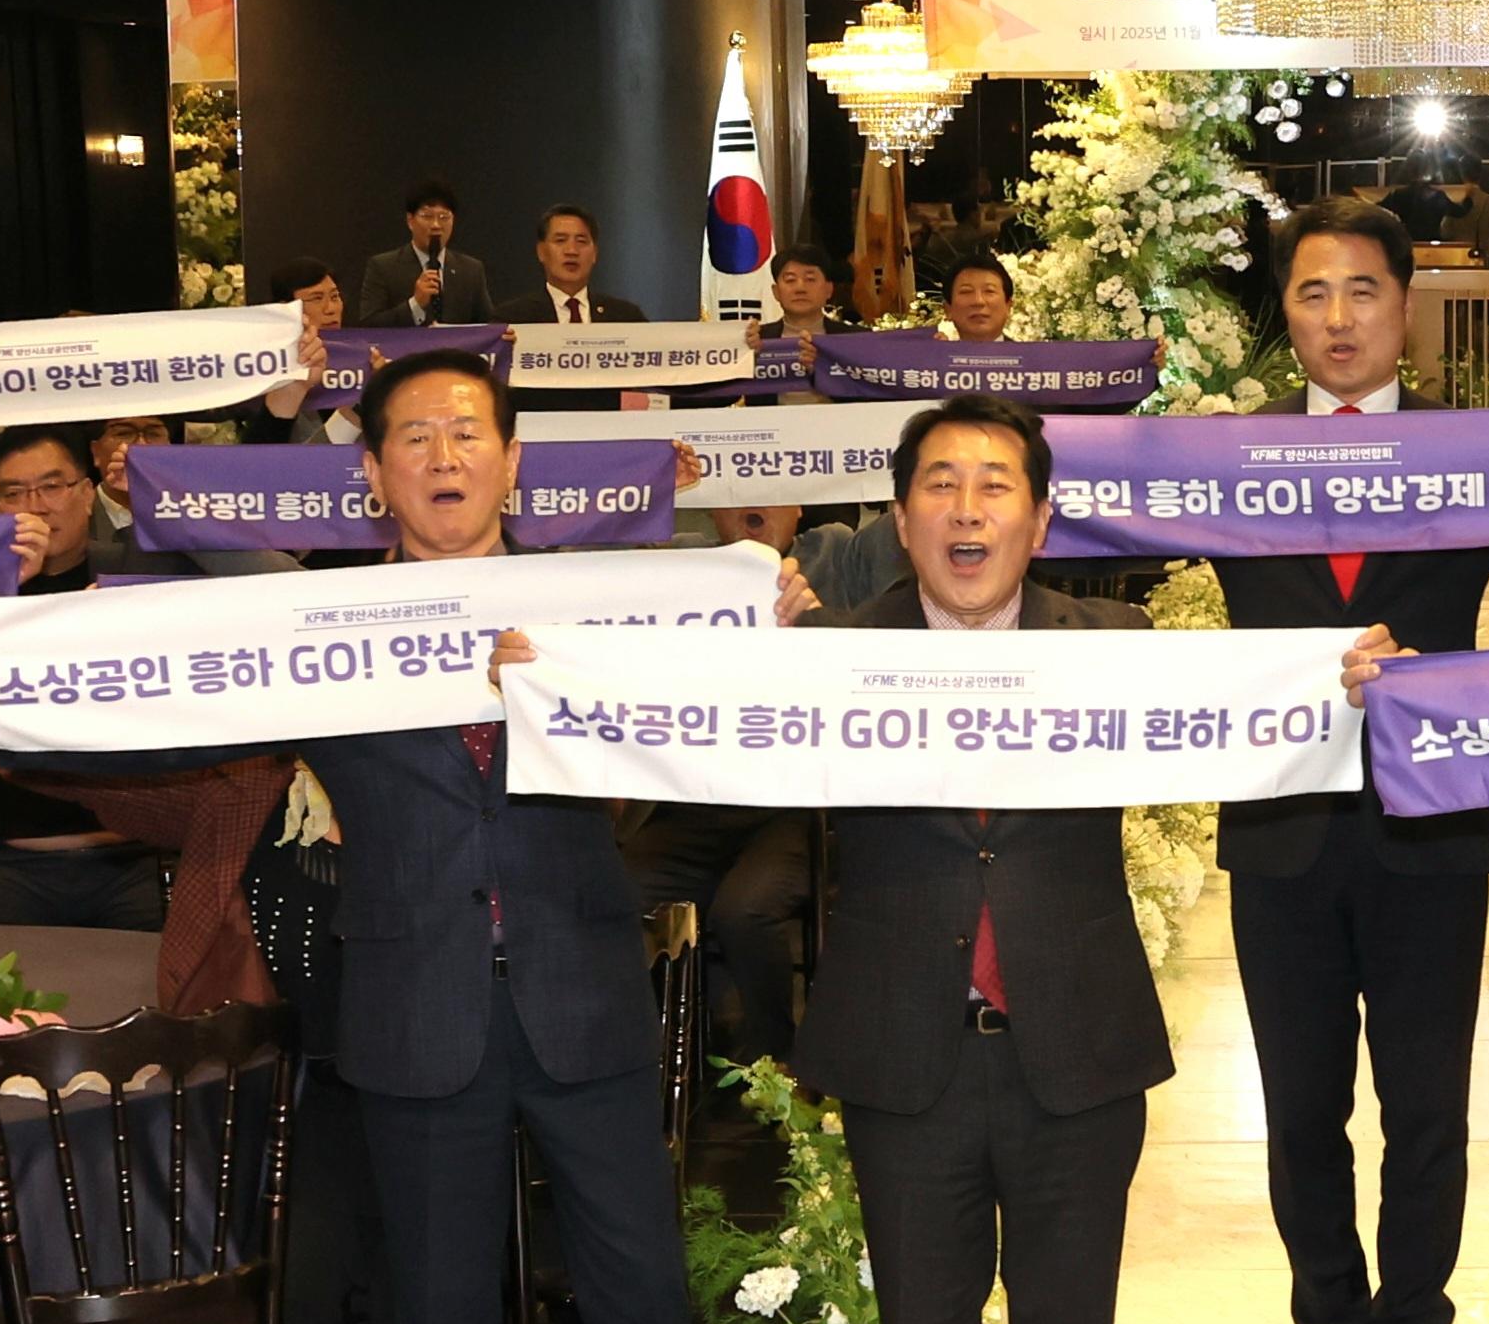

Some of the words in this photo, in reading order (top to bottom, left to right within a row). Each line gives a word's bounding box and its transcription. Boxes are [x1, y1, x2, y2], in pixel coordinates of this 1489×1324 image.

[46, 359, 159, 390] 양산경제
[168, 355, 225, 381] 환하
[234, 349, 287, 377] GO!
[520, 353, 552, 369] 흥하
[558, 353, 590, 369] GO!
[597, 351, 662, 369] 양산경제
[668, 350, 701, 366] 환하
[706, 348, 738, 365] GO!
[903, 369, 939, 388] 흥하
[944, 372, 980, 389] GO!
[987, 372, 1060, 391] 양산경제
[1066, 371, 1104, 389] 환하
[1108, 368, 1142, 385] GO!
[1146, 479, 1223, 517] 흥하
[1236, 479, 1312, 515] GO!
[1326, 473, 1484, 513] 양산경제
[188, 647, 273, 693] 흥하
[289, 639, 373, 684] GO!
[547, 697, 717, 746] 소상공인
[736, 705, 825, 749] 흥하
[842, 709, 927, 749] GO!
[947, 709, 1126, 753] 양산경제
[1144, 708, 1232, 751] 환하
[1248, 700, 1330, 746] GO!
